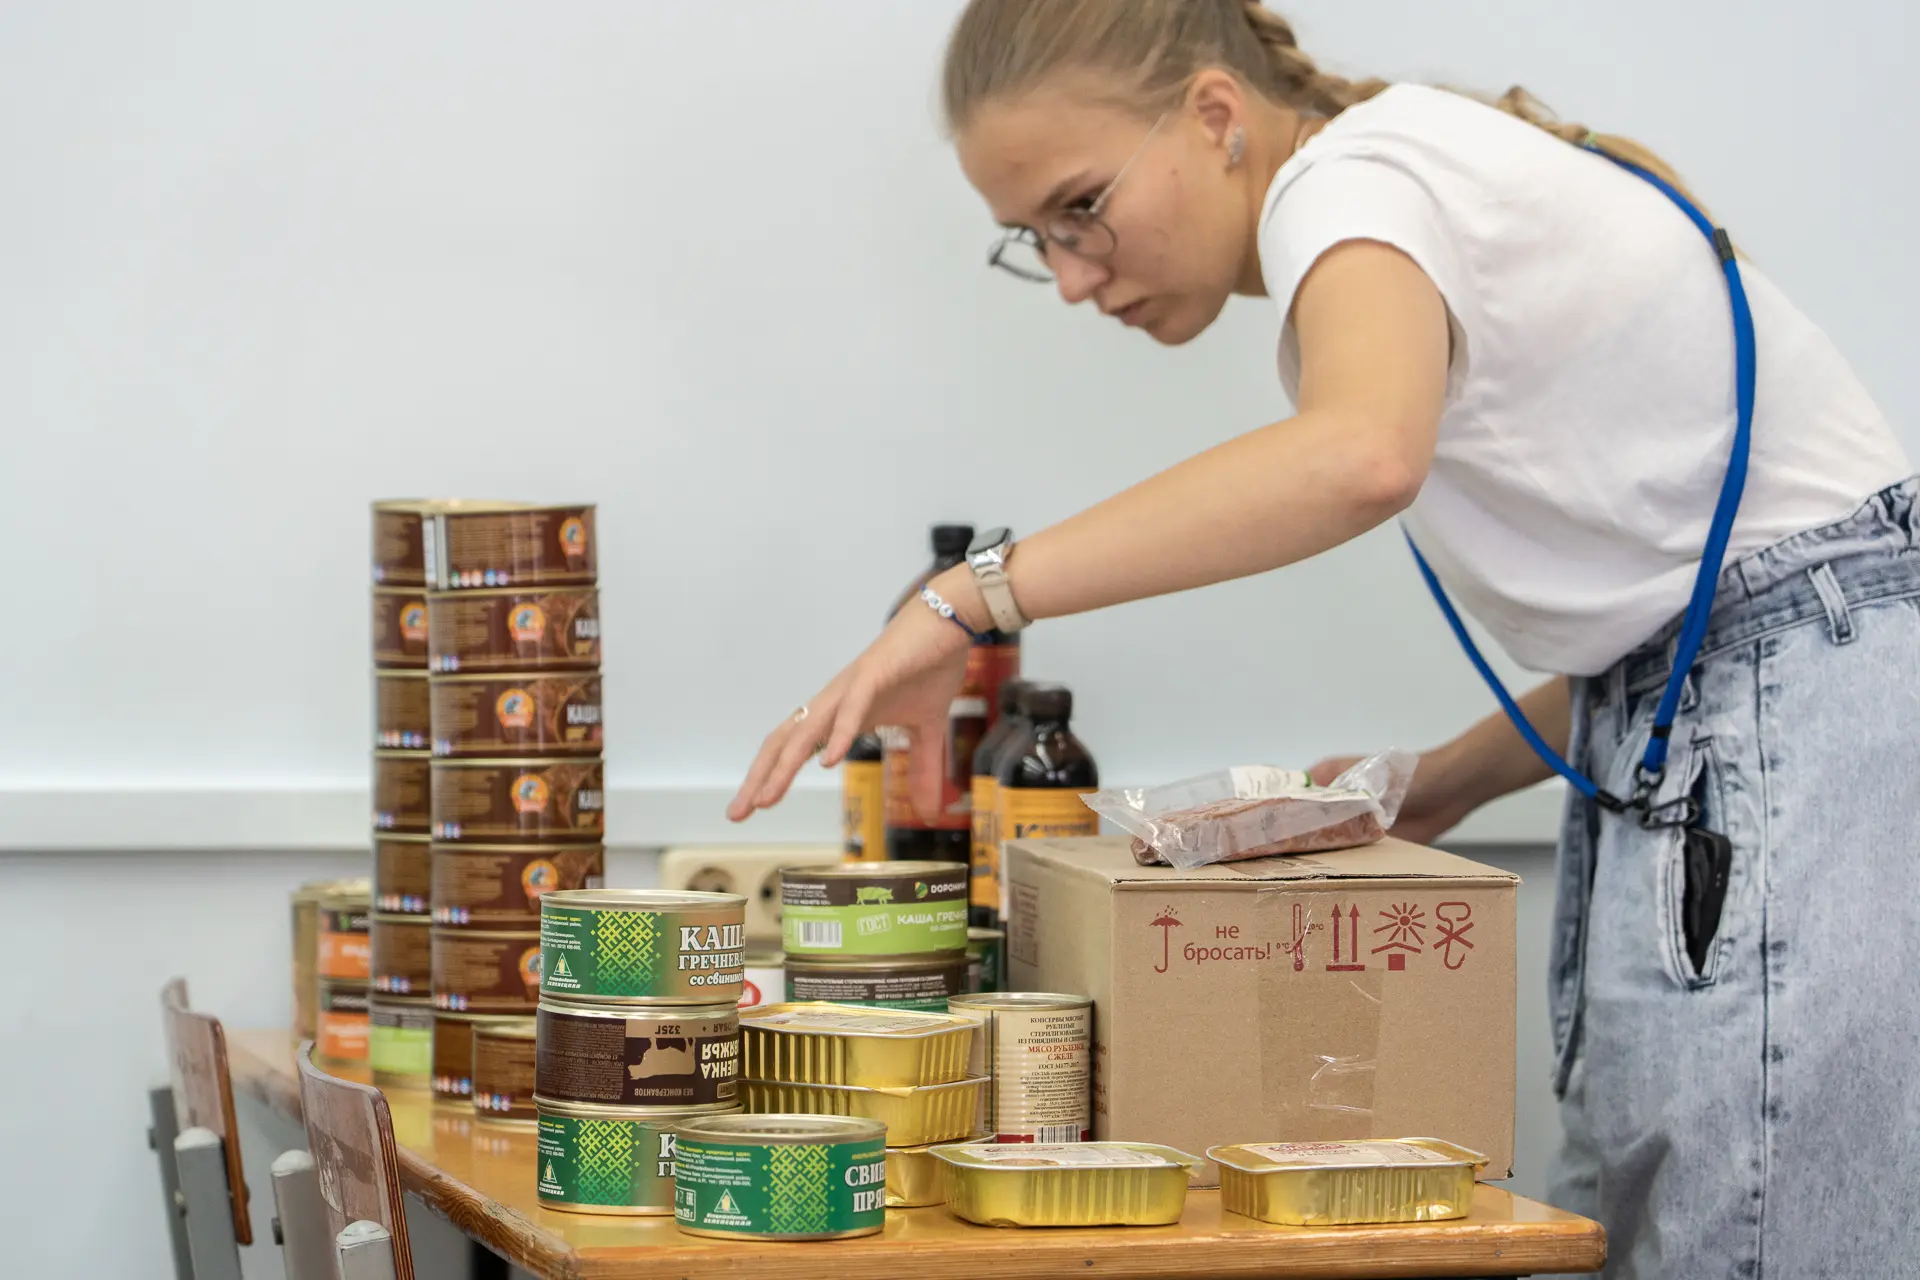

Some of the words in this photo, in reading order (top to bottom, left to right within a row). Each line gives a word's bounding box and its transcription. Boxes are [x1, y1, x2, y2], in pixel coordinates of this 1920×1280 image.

[859, 915, 888, 933] ГОСТ
[897, 913, 934, 925] КАША
[1215, 925, 1240, 939] не
[1183, 942, 1271, 965] бросать!
[689, 975, 705, 986] со
[654, 1024, 681, 1035] 325Г
[1045, 1022, 1075, 1030] РУБЛЕНЫЕ
[1028, 1037, 1063, 1045] ГОВЯДИНЫ
[1028, 1045, 1053, 1053] МЯСО
[1053, 1043, 1085, 1053] РУБЛЕНОЕ
[1047, 1053, 1053, 1061] С
[1053, 1052, 1074, 1060] ЖЕЛЕ
[634, 1086, 683, 1097] КОНСЕРВАНТОВ
[683, 1087, 694, 1096] БЕЗ
